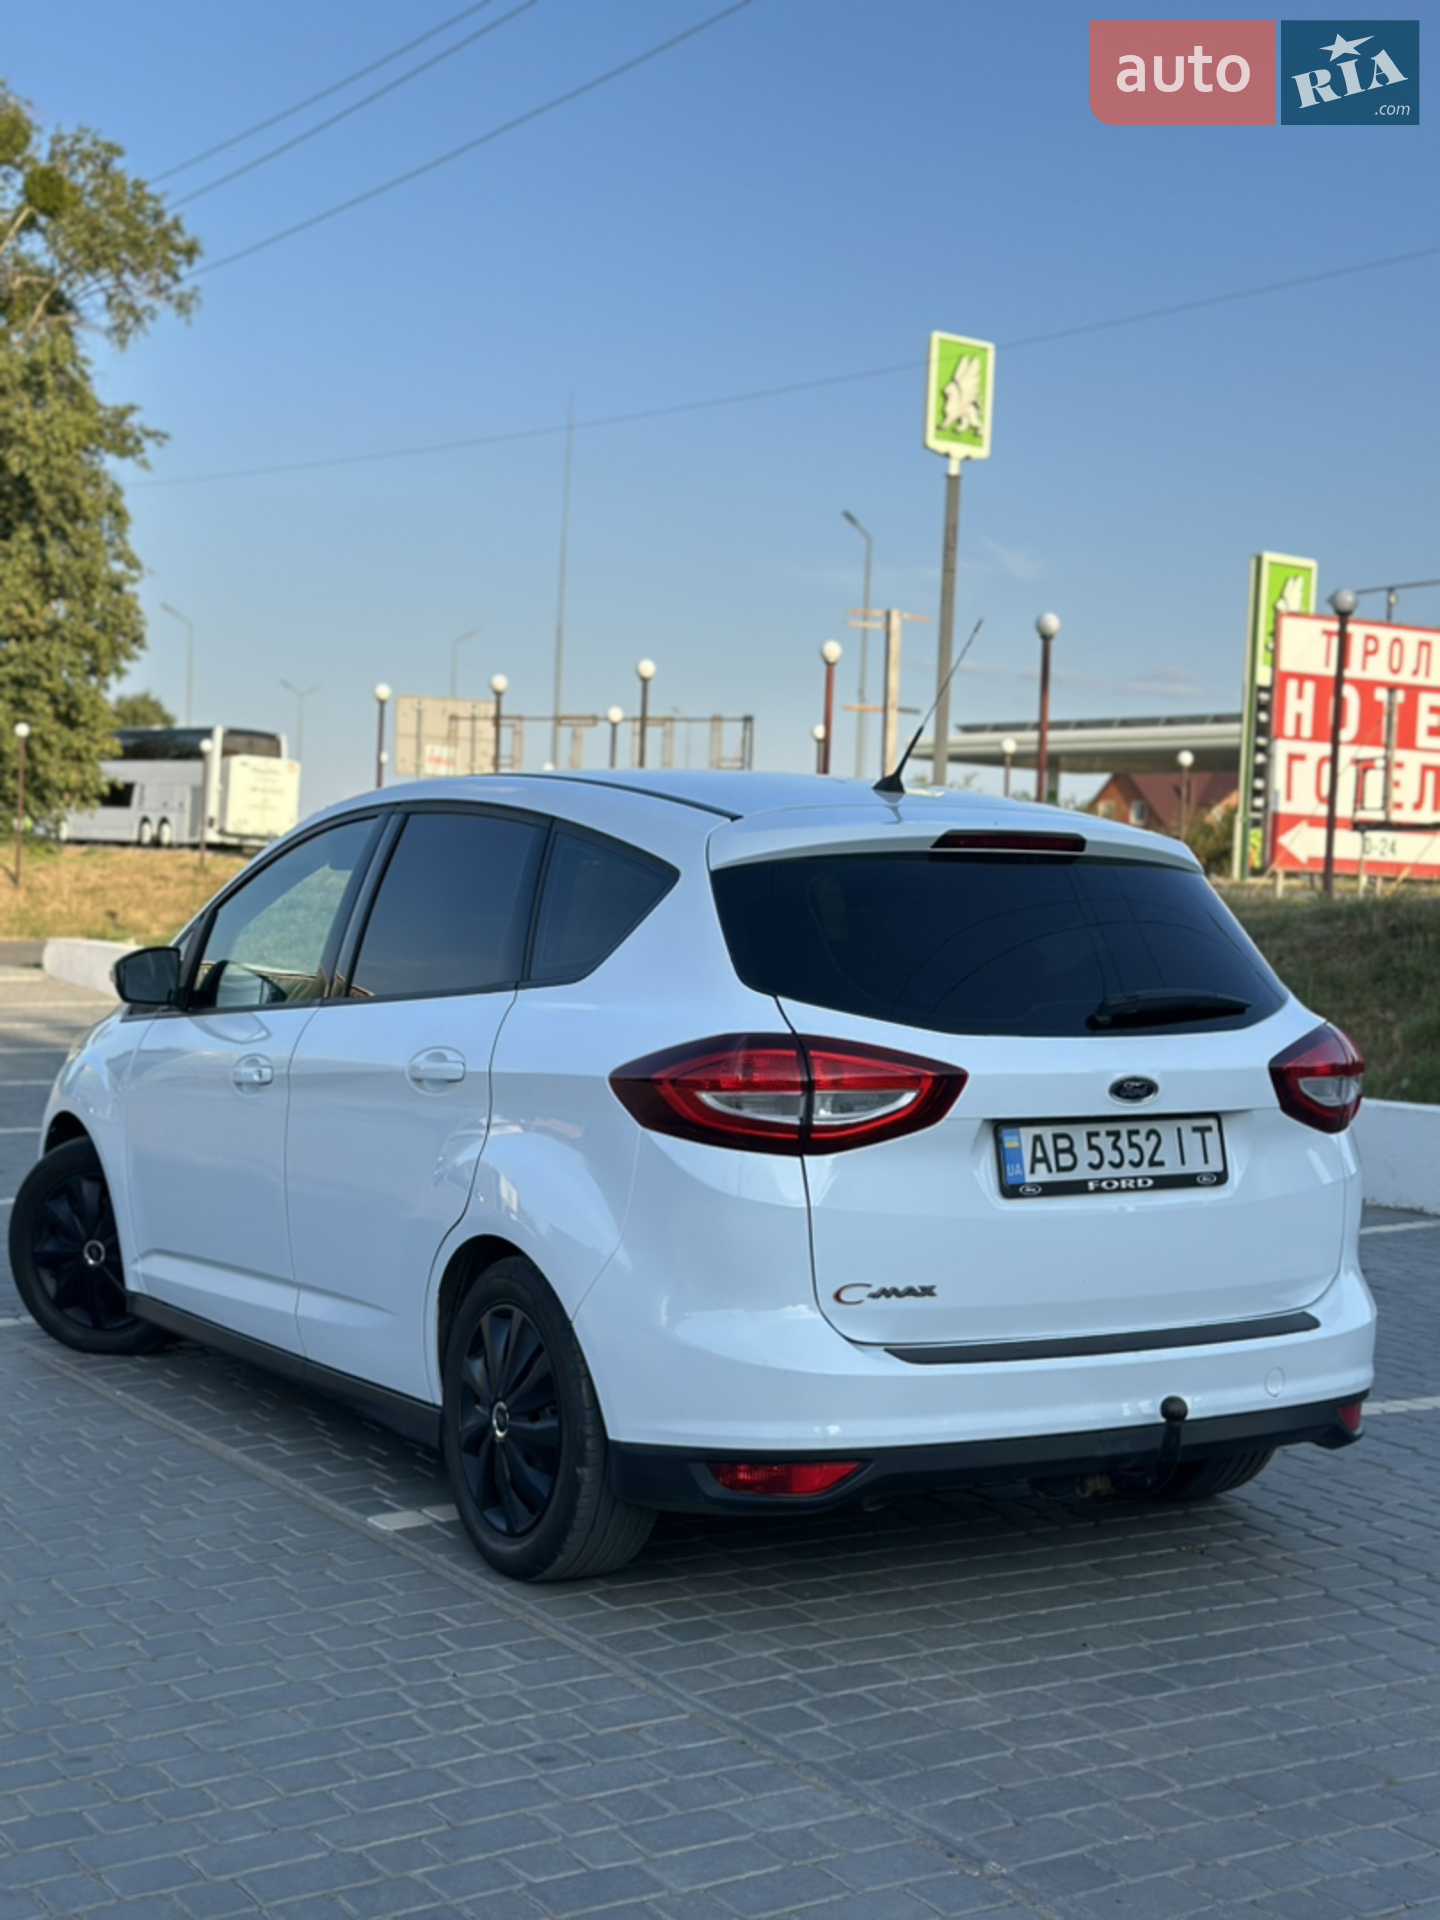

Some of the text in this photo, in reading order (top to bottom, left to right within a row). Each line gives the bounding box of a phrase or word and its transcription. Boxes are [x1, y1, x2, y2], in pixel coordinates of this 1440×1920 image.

[1029, 1132, 1078, 1175] AB
[1086, 1128, 1166, 1171] 5352
[1006, 1163, 1023, 1178] UA
[1087, 1177, 1154, 1192] FORD
